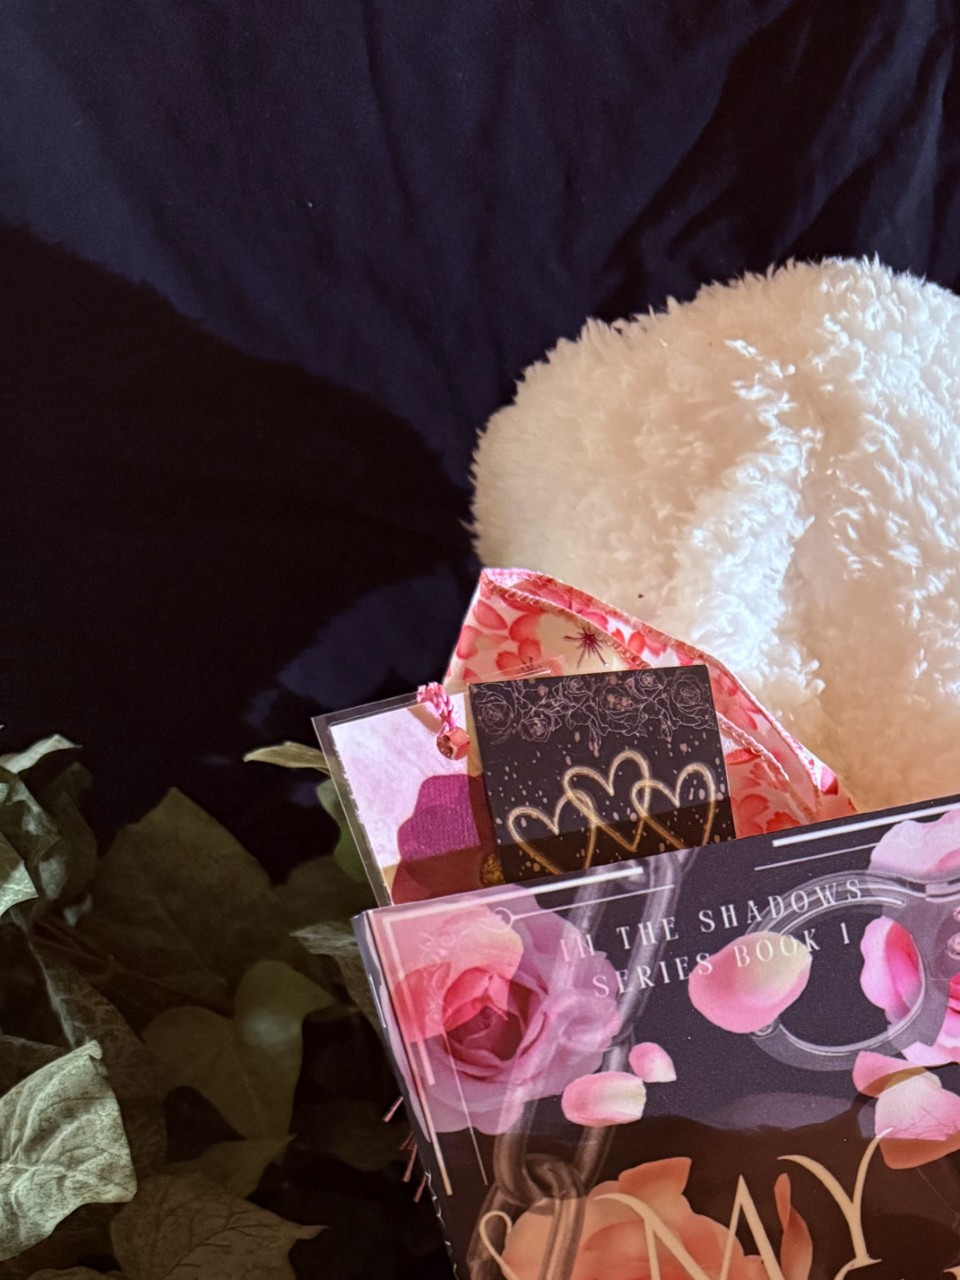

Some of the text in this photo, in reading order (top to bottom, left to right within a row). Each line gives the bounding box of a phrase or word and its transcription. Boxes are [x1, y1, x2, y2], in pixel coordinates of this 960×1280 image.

[560, 877, 862, 963] IN THE SHADOWS
[592, 951, 714, 999] SERIES
[732, 927, 821, 969] BOOK
